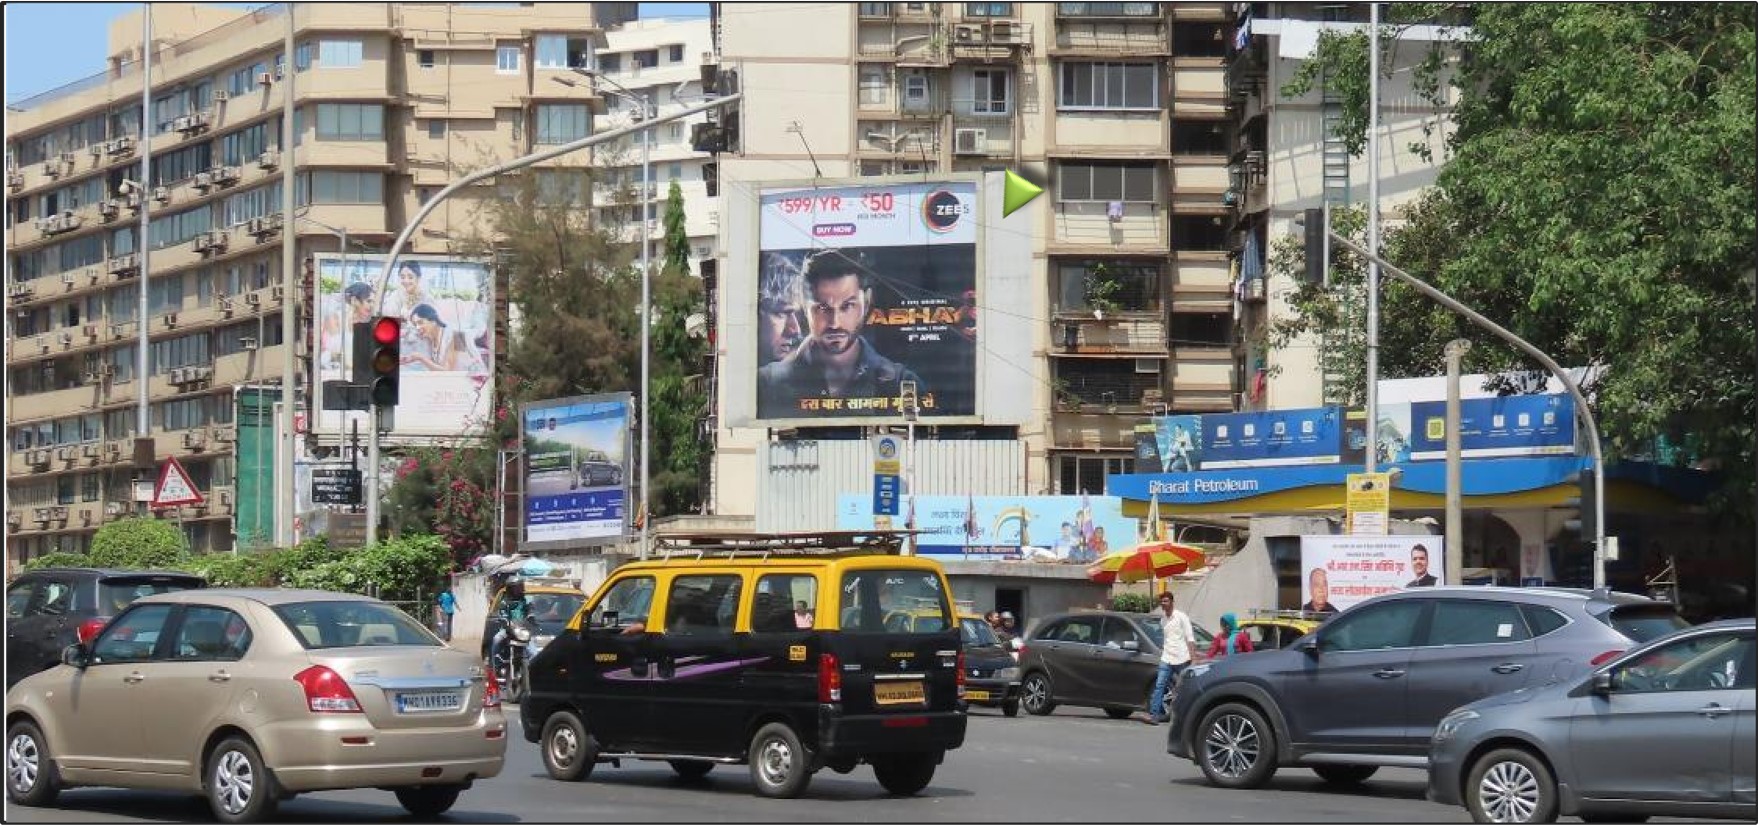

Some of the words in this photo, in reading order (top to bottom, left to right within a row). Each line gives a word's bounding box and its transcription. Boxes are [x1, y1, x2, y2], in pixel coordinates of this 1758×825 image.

[816, 226, 832, 234] BUY
[833, 225, 853, 233] NOW
[866, 307, 961, 325] ABHAY
[847, 398, 888, 410] सामना
[1149, 480, 1189, 494] Bharat
[1194, 479, 1259, 492] Petroleum
